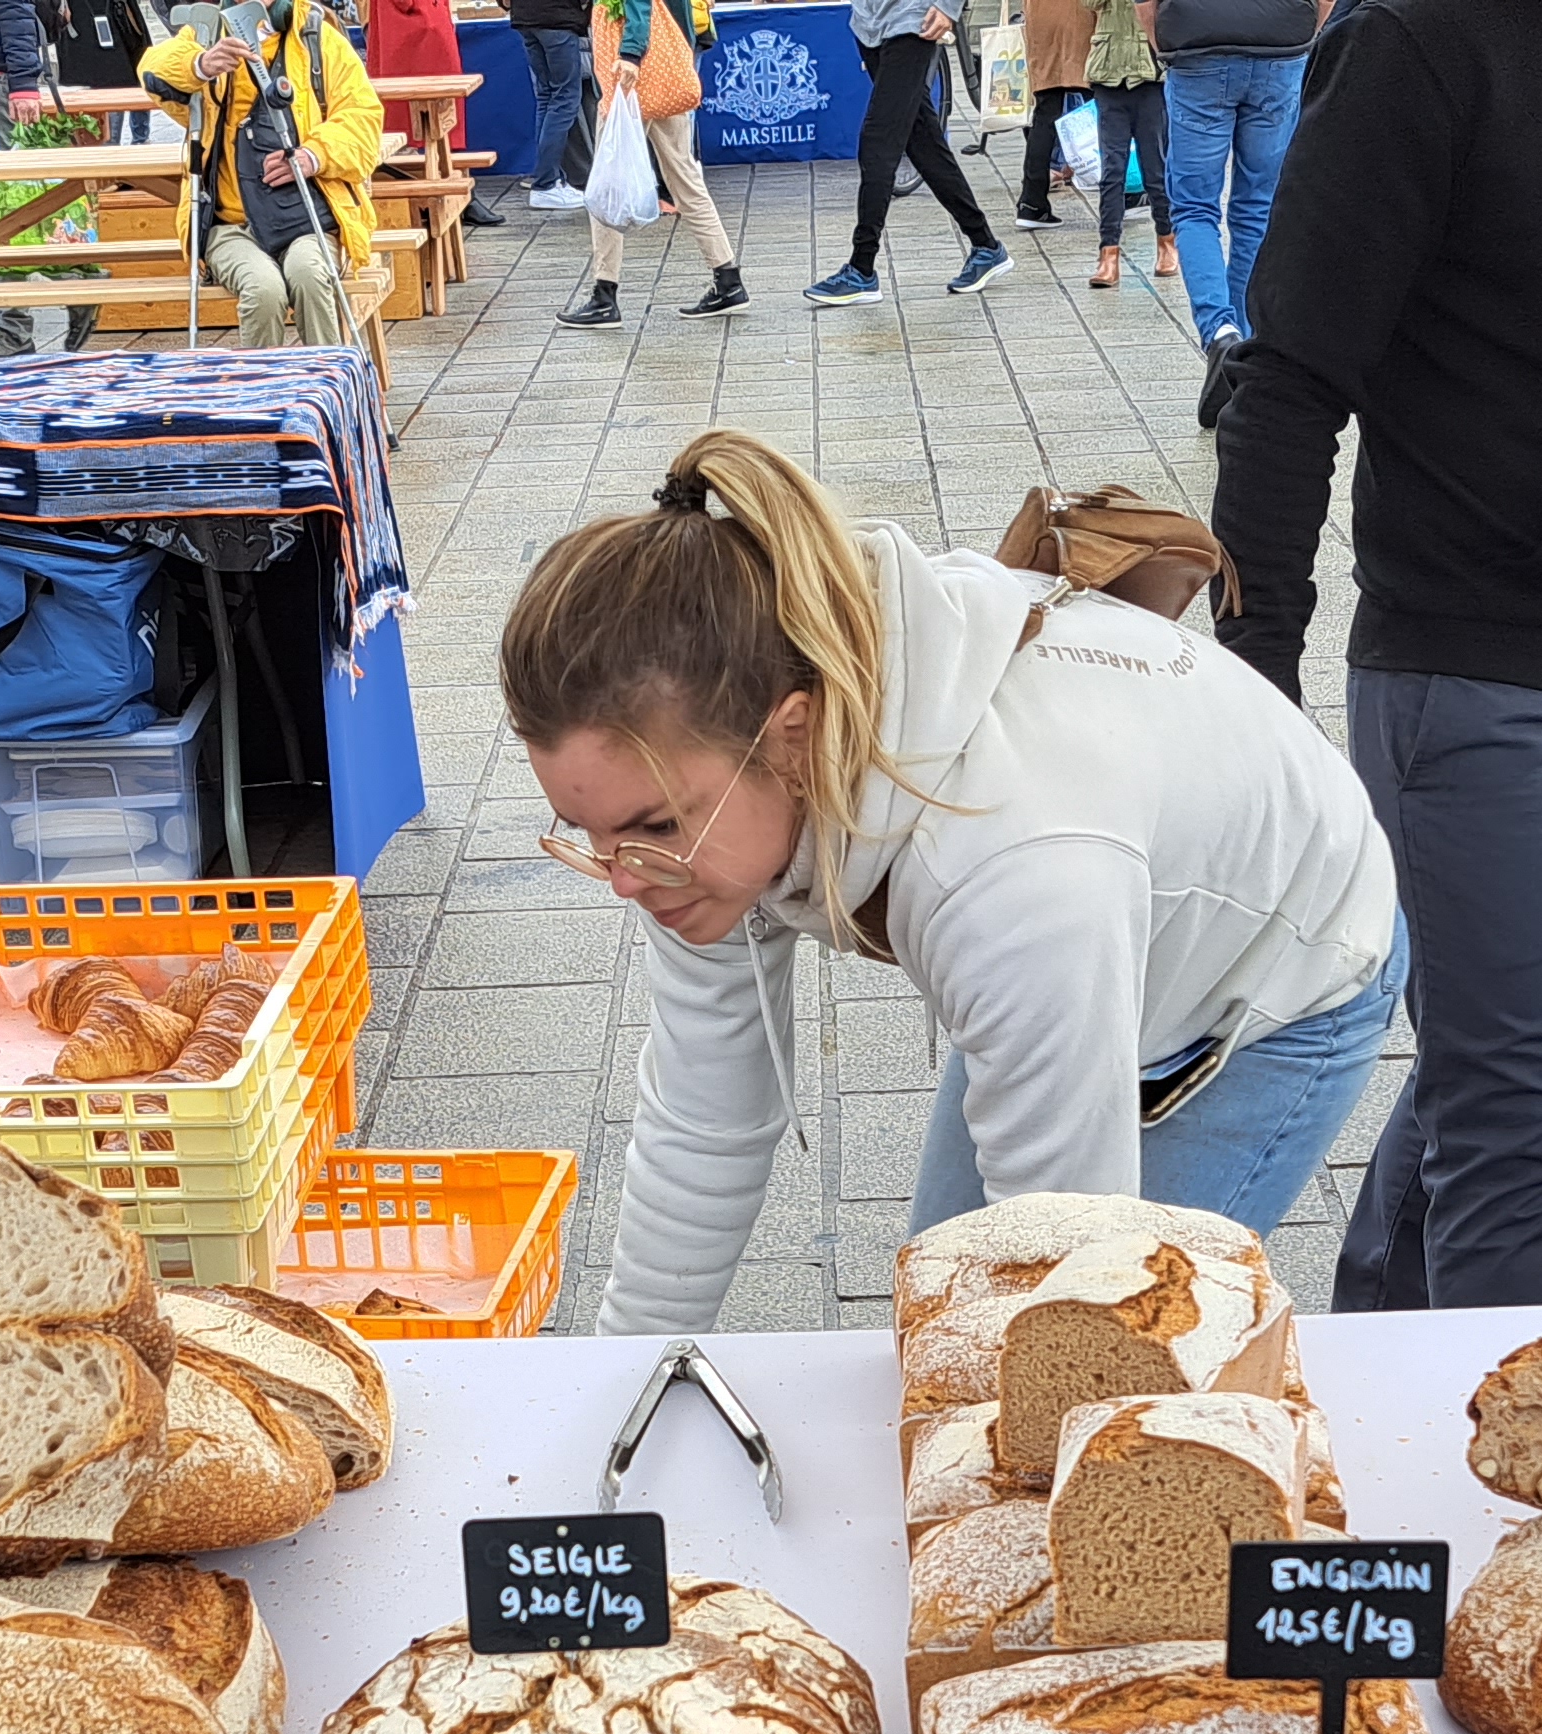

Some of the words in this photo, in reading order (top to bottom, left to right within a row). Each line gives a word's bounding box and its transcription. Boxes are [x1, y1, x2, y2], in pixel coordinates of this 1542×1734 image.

[721, 123, 817, 147] MARSEILLE
[1033, 643, 1152, 677] MARSEILLE
[508, 1543, 632, 1578] SEIGLE
[1270, 1557, 1432, 1593] ENGRAIN
